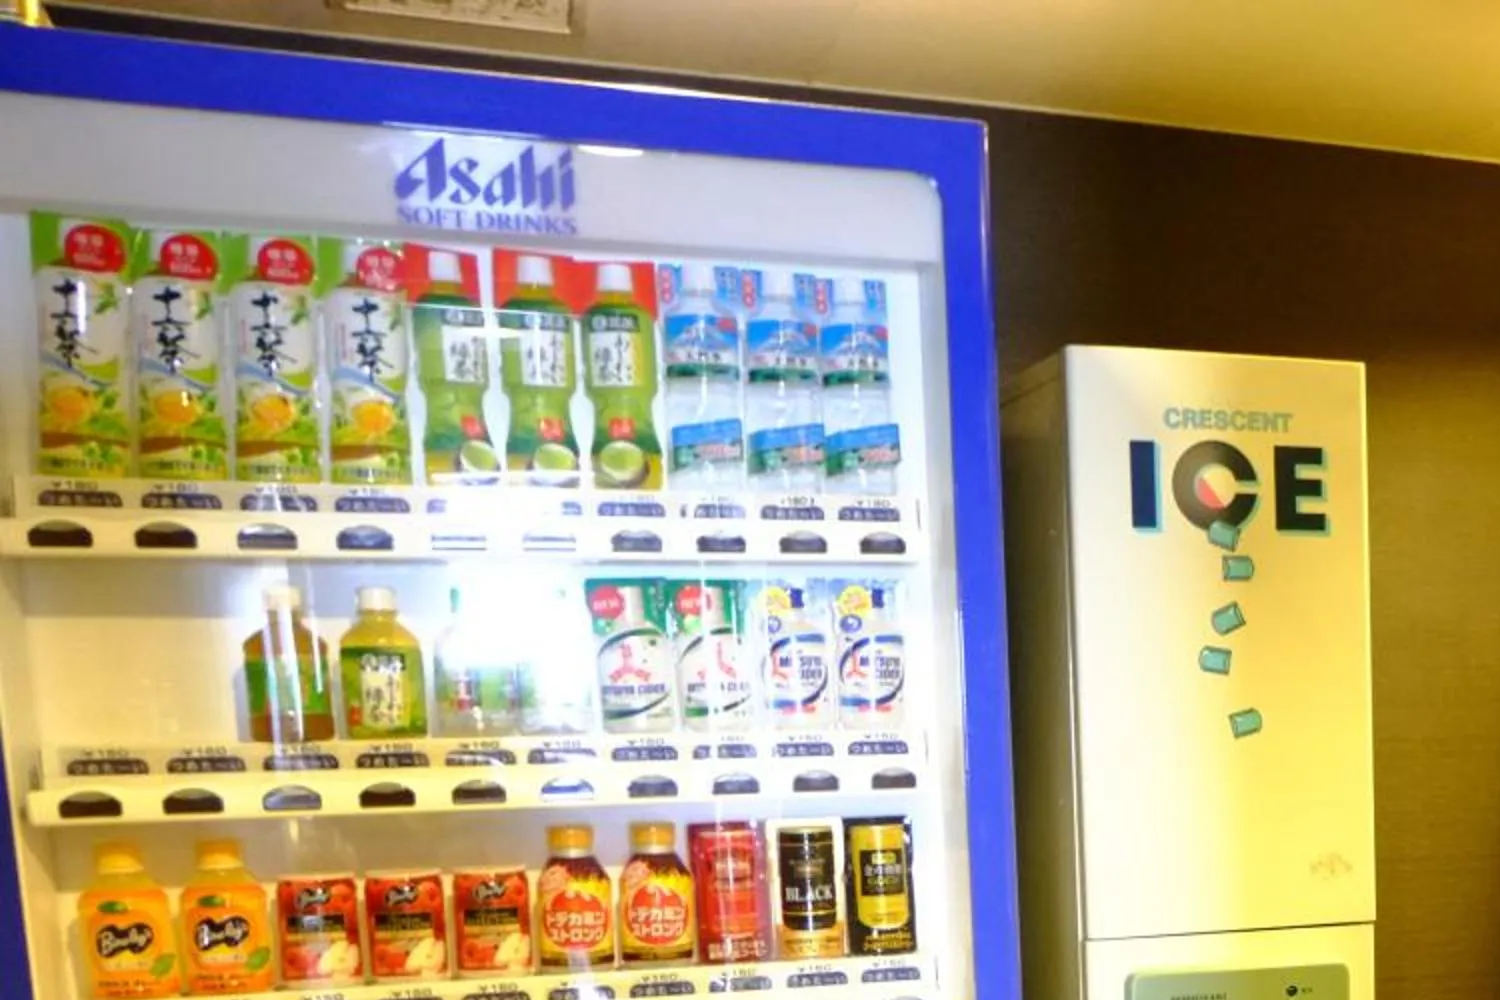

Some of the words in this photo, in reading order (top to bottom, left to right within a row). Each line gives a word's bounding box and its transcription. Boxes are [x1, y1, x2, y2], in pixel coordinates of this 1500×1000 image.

[394, 137, 576, 212] Asahi
[397, 205, 470, 227] SOFT
[475, 211, 578, 235] DRINKS
[1163, 407, 1293, 433] CRESCENT
[1129, 438, 1331, 537] ICE
